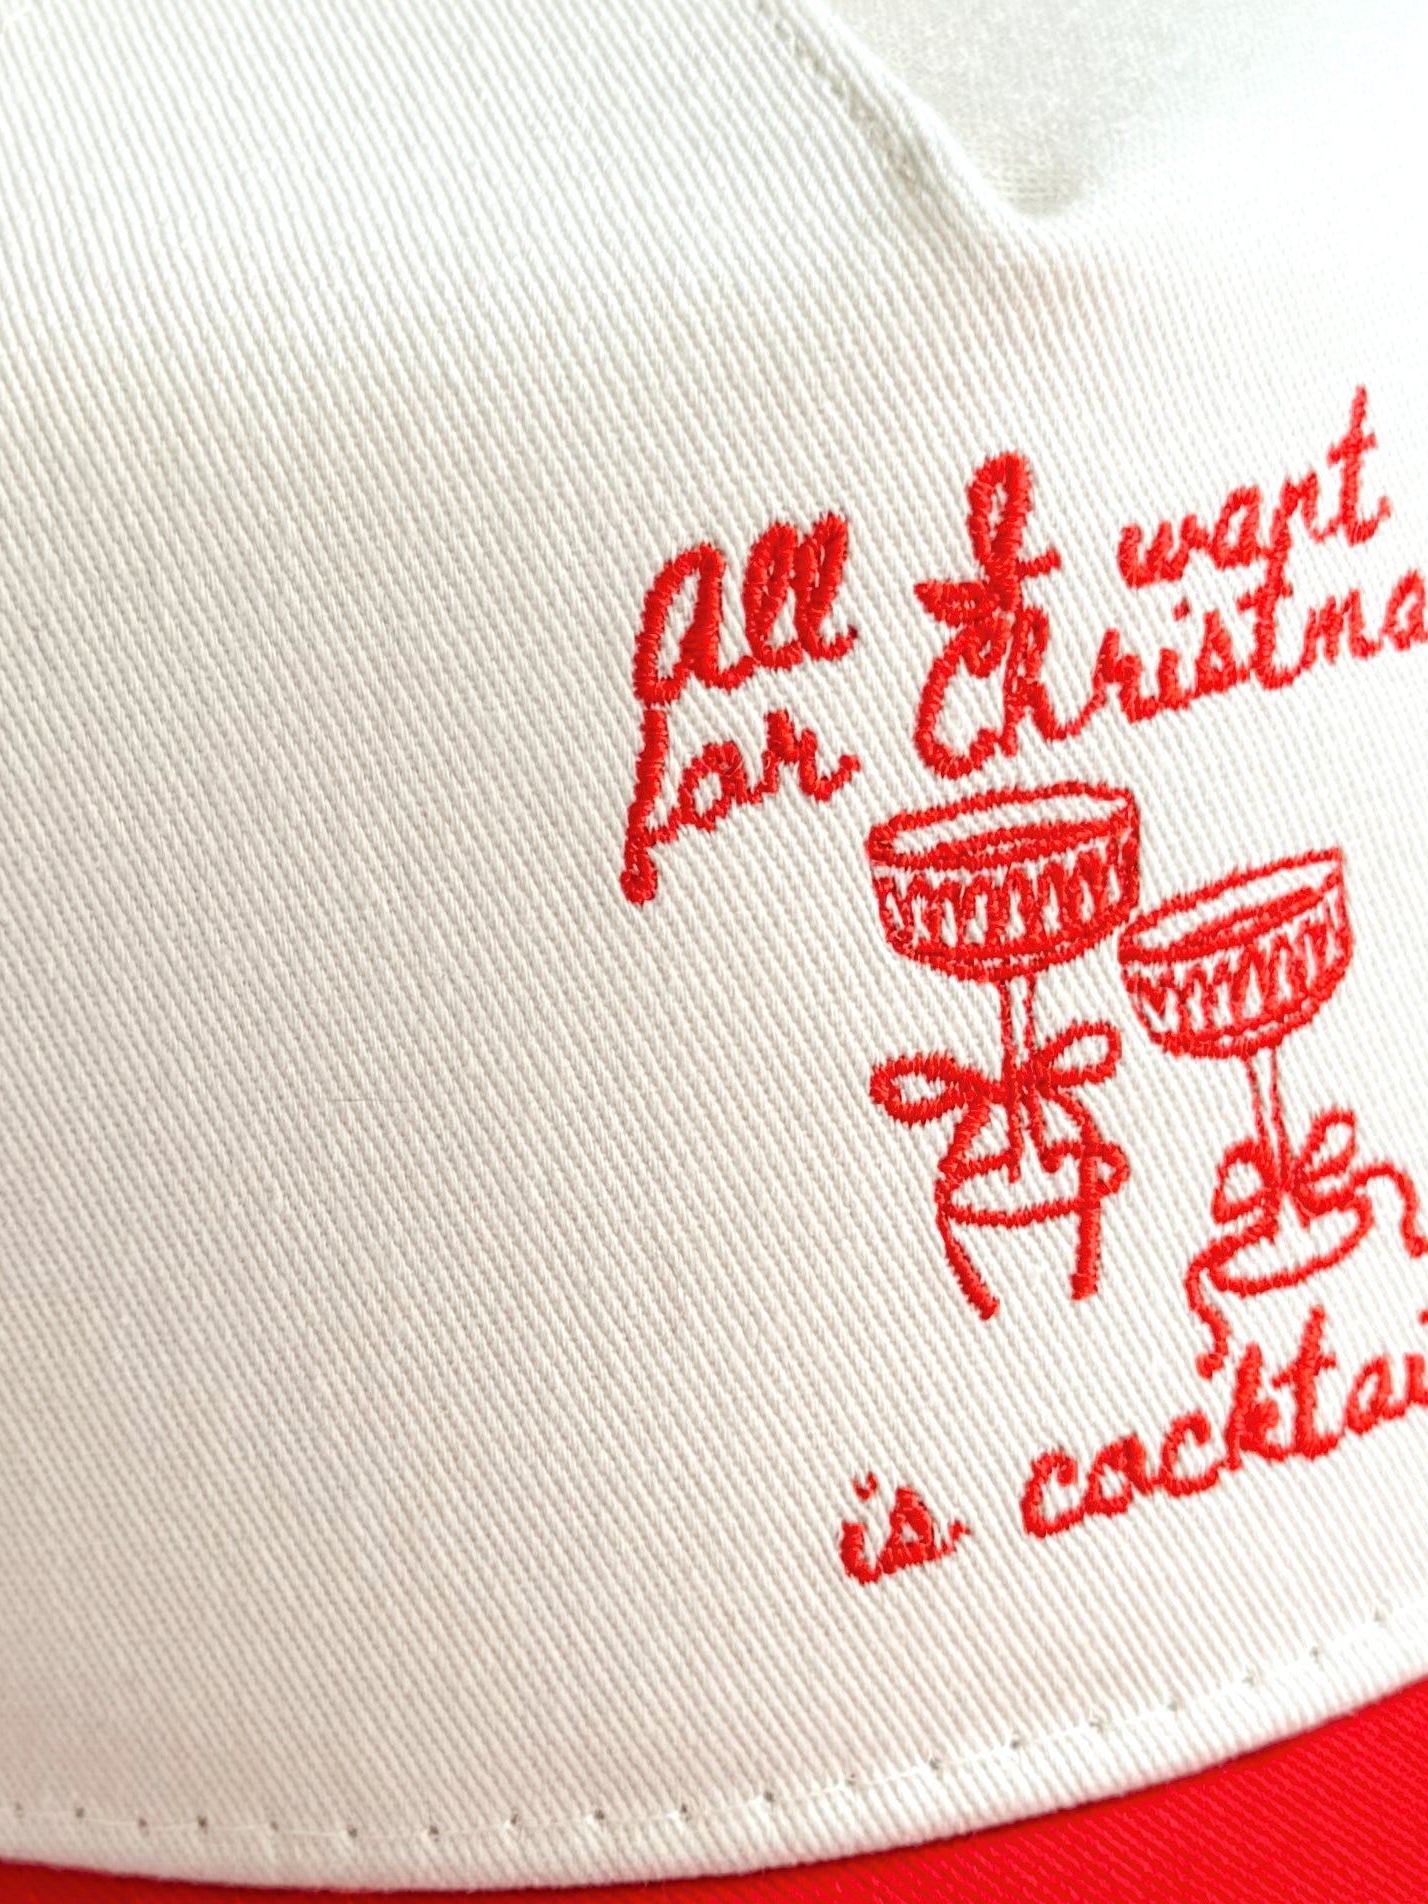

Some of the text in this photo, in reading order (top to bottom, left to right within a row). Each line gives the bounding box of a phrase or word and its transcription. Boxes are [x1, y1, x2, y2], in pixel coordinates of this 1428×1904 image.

[913, 450, 1062, 629] I
[1117, 384, 1392, 590] want
[619, 708, 861, 907] for
[837, 1471, 972, 1585] is
